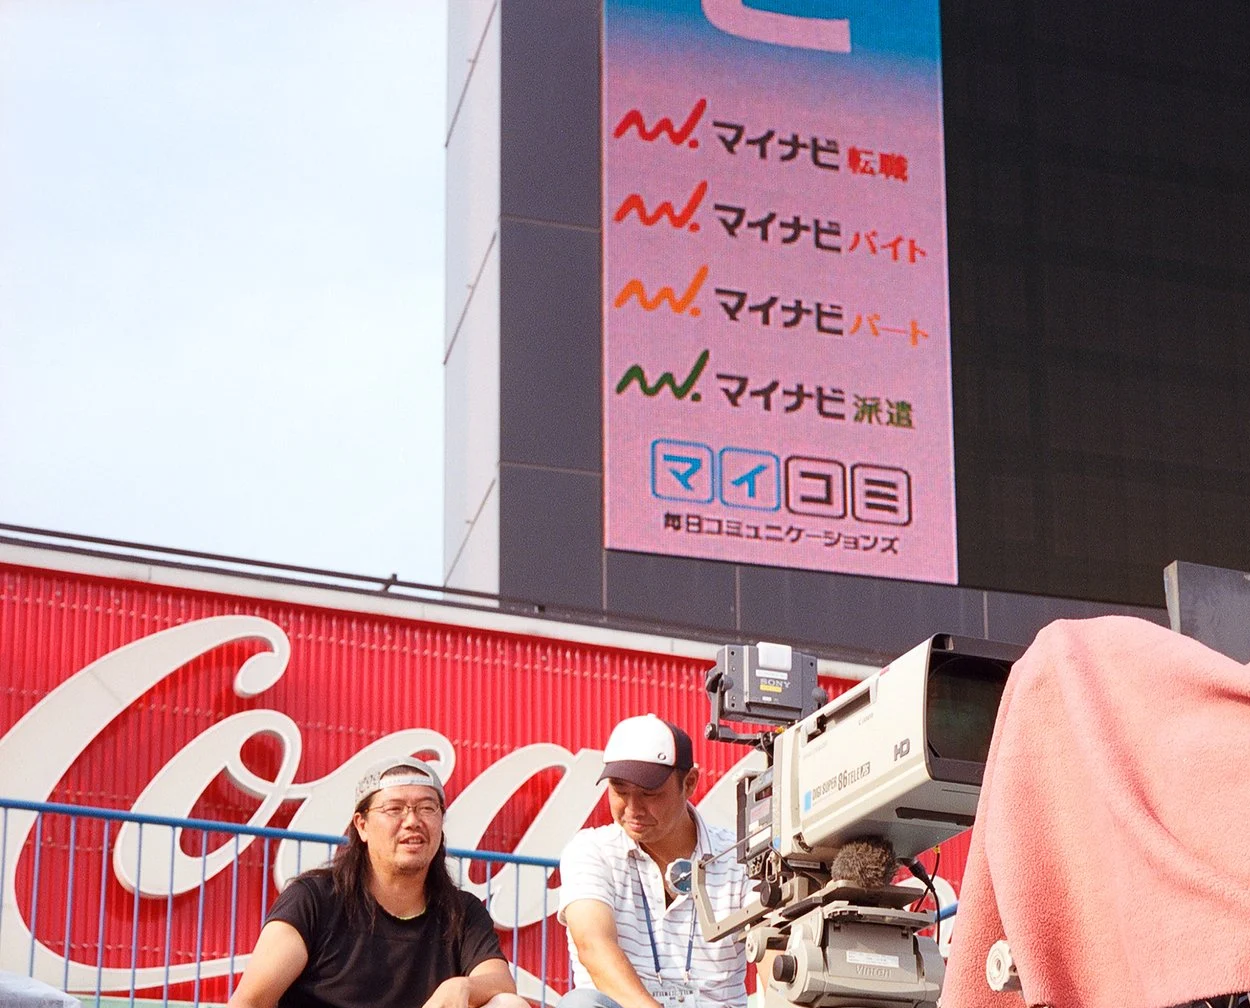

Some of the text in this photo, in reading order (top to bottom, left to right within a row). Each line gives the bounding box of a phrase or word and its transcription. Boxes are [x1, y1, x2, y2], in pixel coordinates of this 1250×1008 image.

[712, 120, 909, 182] マイナビ転職
[713, 203, 927, 264] マイナビバイト
[716, 373, 915, 430] マイナビ派遣
[662, 453, 899, 513] マイコミ
[663, 511, 899, 555] 毎日コミュニケーションズ
[760, 678, 791, 689] SONY
[893, 738, 910, 762] HD
